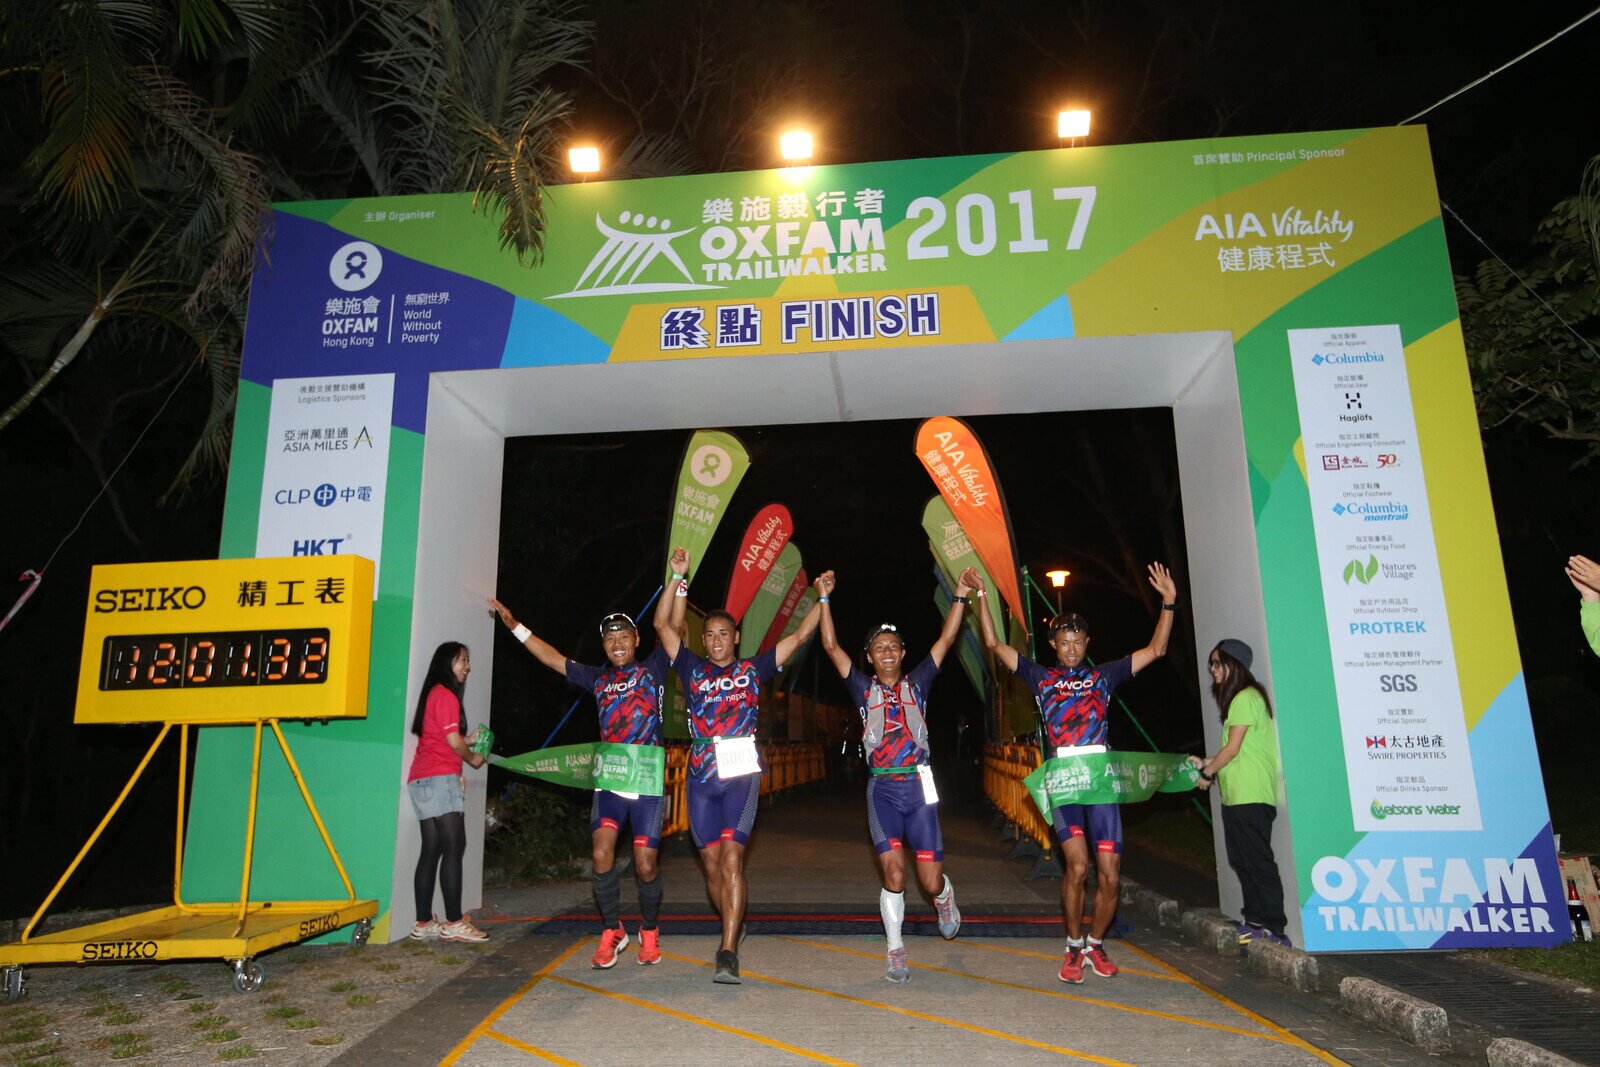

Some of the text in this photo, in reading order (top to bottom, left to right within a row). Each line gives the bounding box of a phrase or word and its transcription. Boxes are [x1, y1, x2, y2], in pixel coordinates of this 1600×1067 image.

[1247, 150, 1296, 163] Principal
[1299, 149, 1345, 161] Sponsor
[702, 188, 885, 223] 樂施毅行者
[389, 209, 435, 223] Organiser
[905, 185, 1097, 260] 2017
[1194, 205, 1354, 243] AIA Vitality
[700, 217, 886, 260] OXFAM
[1217, 242, 1336, 273] 健康程式
[702, 253, 887, 282] TRAILWALKER
[325, 295, 380, 316] 樂施會
[404, 292, 450, 305] 無窮世界
[403, 309, 432, 320] World
[660, 292, 940, 351] 終點 FINISH
[322, 316, 378, 334] OXFAM
[402, 320, 442, 331] Without
[323, 336, 375, 348] Hong Kong
[402, 332, 440, 344] Poverty
[1325, 352, 1384, 364] Columbia
[298, 393, 366, 405] Logistics Sponsors
[1340, 414, 1373, 423] Haglöfs
[284, 427, 349, 441] 亞洲萬里通
[283, 440, 348, 453] ASIA MILES
[1337, 441, 1372, 449] Engineering
[934, 431, 987, 507] AIA Vitality
[923, 449, 968, 507] 健康程式
[275, 486, 372, 504] CLP 中電
[683, 485, 720, 510] 樂施會
[678, 501, 714, 525] OXFAM
[1347, 502, 1408, 514] Columbia
[1364, 513, 1409, 522] montrail
[293, 538, 344, 557] HKT
[741, 515, 782, 572] AIA Vitality
[758, 529, 788, 571] 健康程式
[1382, 563, 1417, 571] Natures
[1383, 571, 1414, 580] Village
[94, 577, 345, 613] SEIKO 精工表
[1350, 621, 1426, 635] PROTREK
[1384, 660, 1420, 668] Management
[1380, 674, 1418, 692] SGS
[705, 690, 747, 702] team nepal
[1389, 735, 1445, 748] 太古地產
[1368, 750, 1447, 760] SWIRE PROPERTIES
[604, 764, 628, 775] OXFAM
[1045, 775, 1091, 789] OXFAM
[1426, 804, 1461, 815] water
[1311, 855, 1547, 904] OXFAM
[300, 913, 340, 937] SEIKO
[1318, 906, 1555, 933] TRAILWALKER
[82, 940, 159, 960] SEIKO
